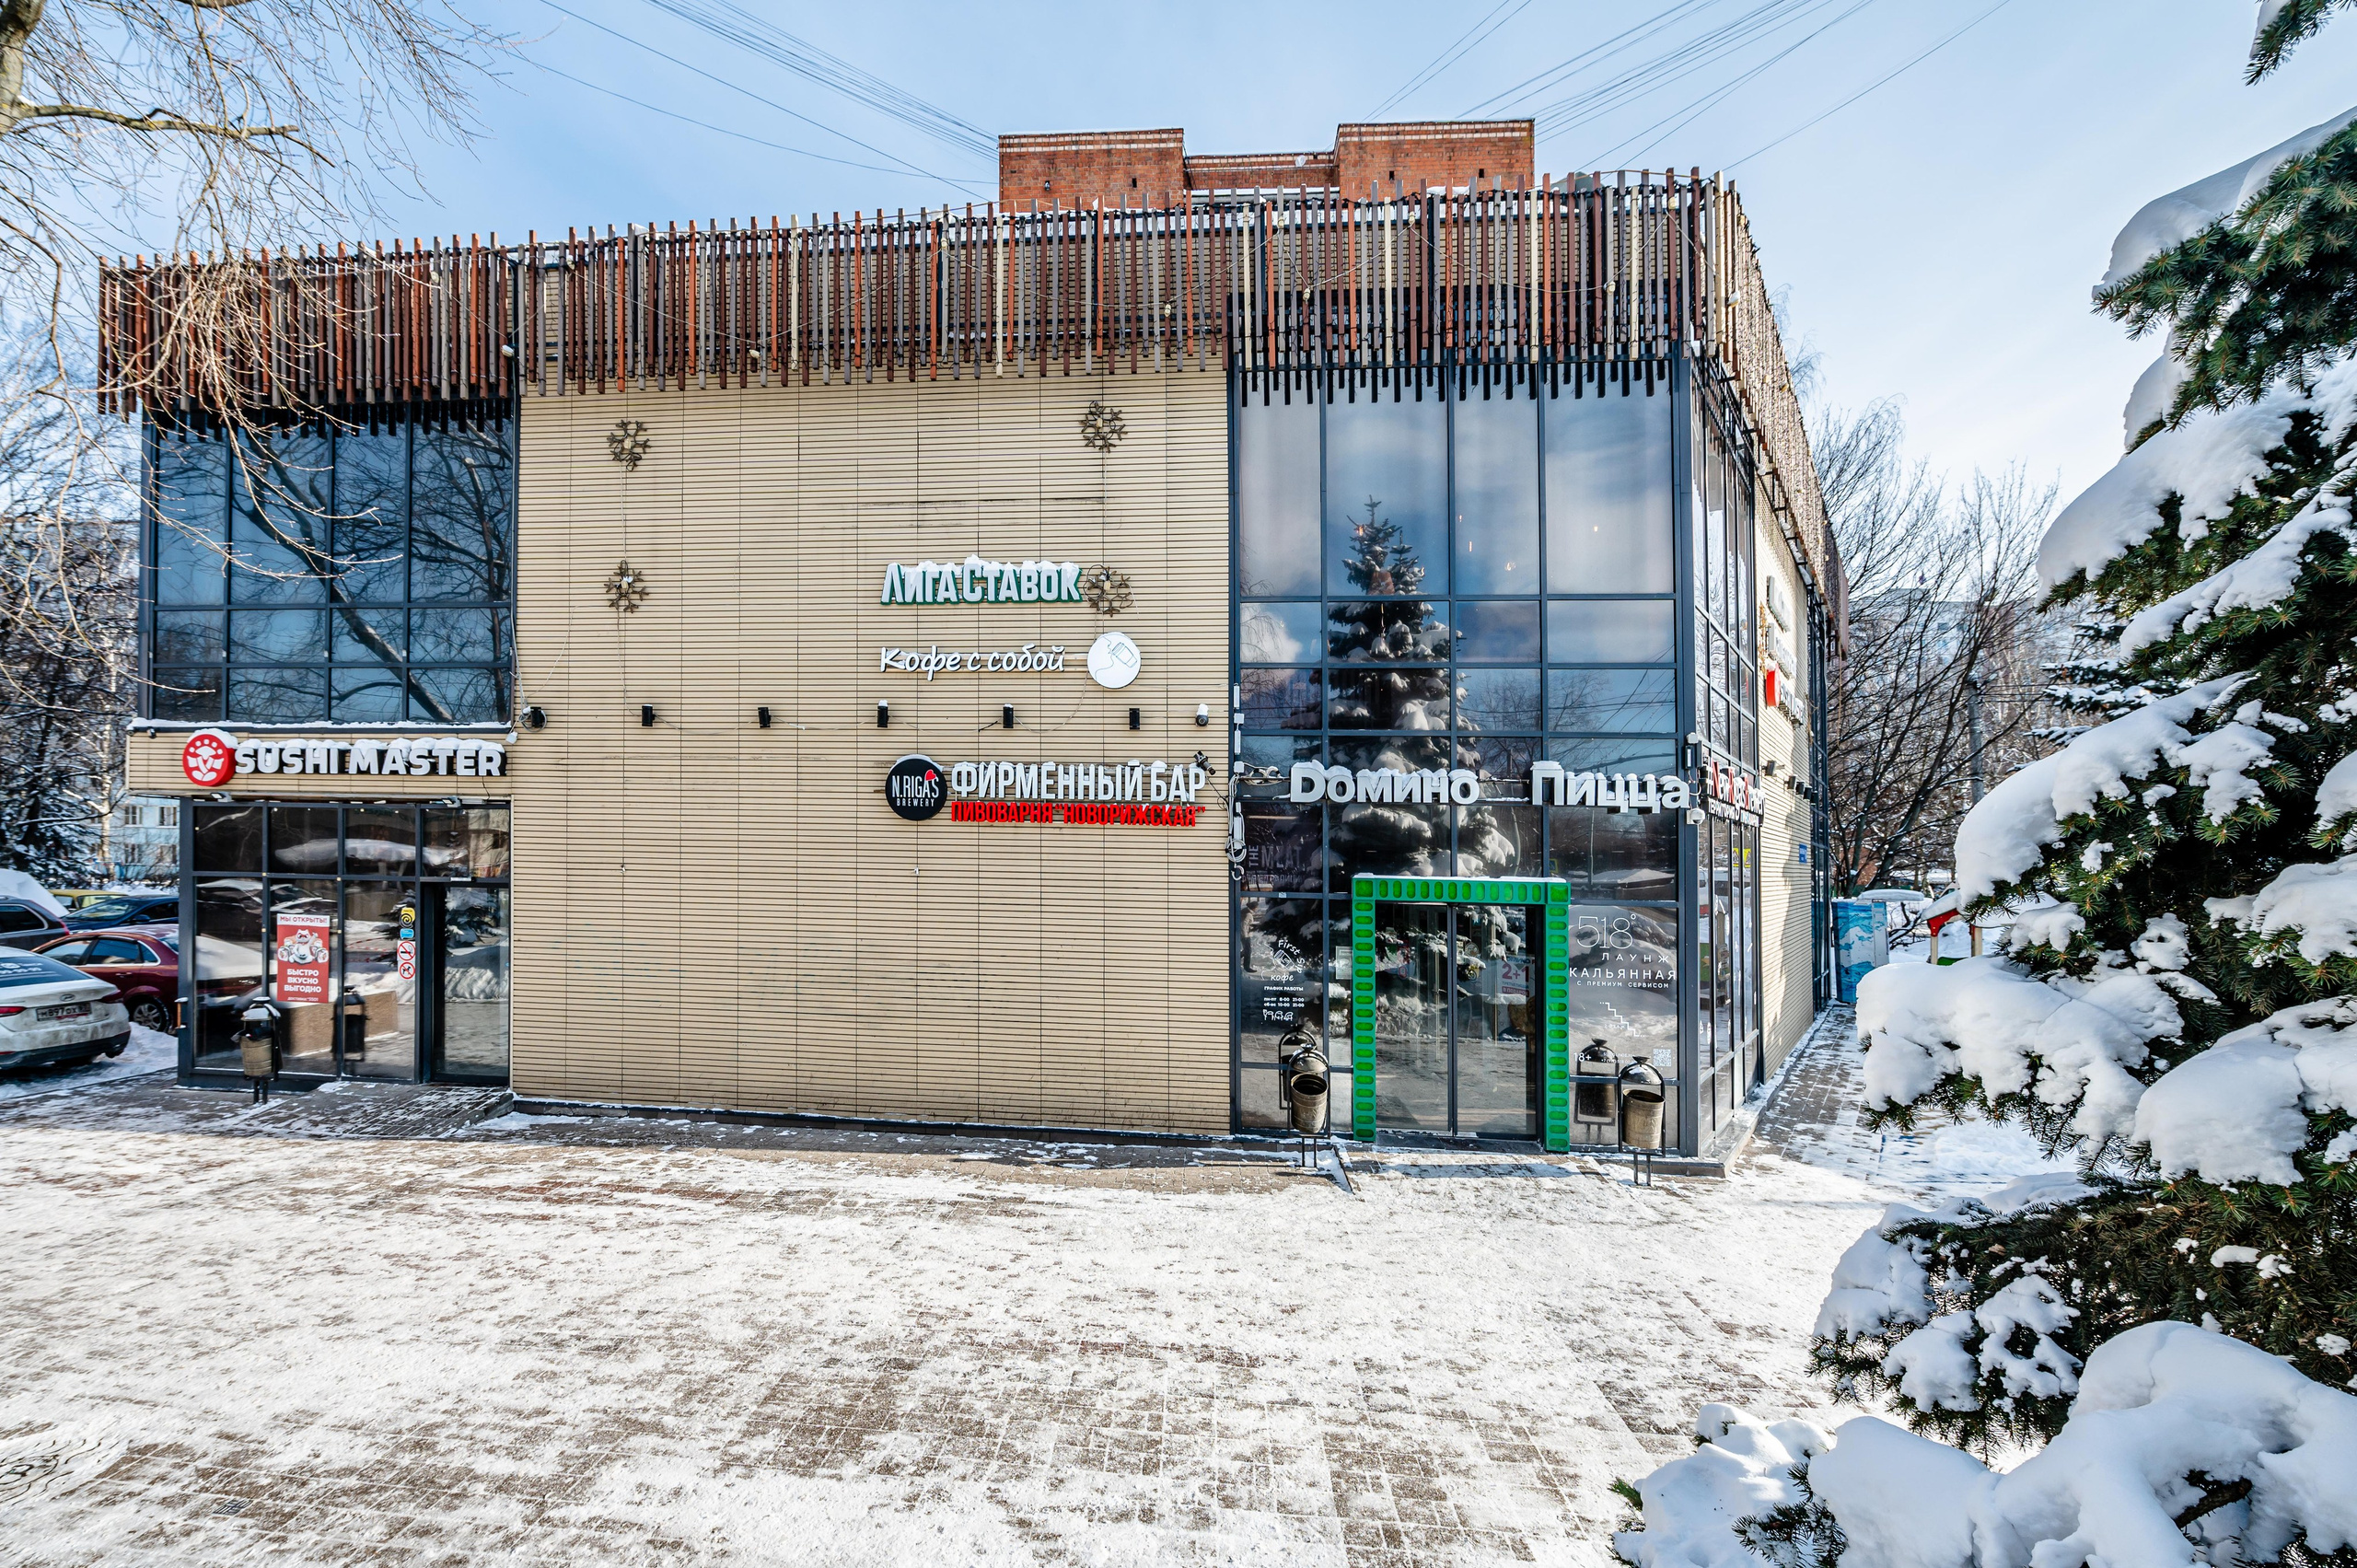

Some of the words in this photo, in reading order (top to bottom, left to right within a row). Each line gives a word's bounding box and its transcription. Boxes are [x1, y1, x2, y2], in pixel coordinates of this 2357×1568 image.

[880, 645, 961, 681] Кофе
[967, 652, 981, 671] с
[987, 644, 1065, 672] собой
[235, 747, 339, 774] SUSHI
[348, 748, 502, 776] MASTER
[951, 761, 1144, 801] ФИРМЕННЫЙ
[1151, 763, 1206, 802] БАР
[1531, 767, 1690, 813] Пицца
[896, 797, 935, 807] BREWERY
[951, 801, 1053, 823] ПИВОВАРНЯ
[1248, 844, 1259, 867] THE
[1278, 939, 1301, 956] First
[1601, 952, 1669, 963] ЛАУНЖ
[287, 969, 319, 977] БЫСТРО
[1271, 973, 1295, 984] кофе
[1502, 963, 1529, 982] 2+1
[1569, 968, 1676, 981] КАЛЬЯННАЯ
[284, 984, 322, 993] ВЫГОДНО
[287, 977, 319, 985] ВКУСНО
[1573, 1052, 1592, 1063] 18+
